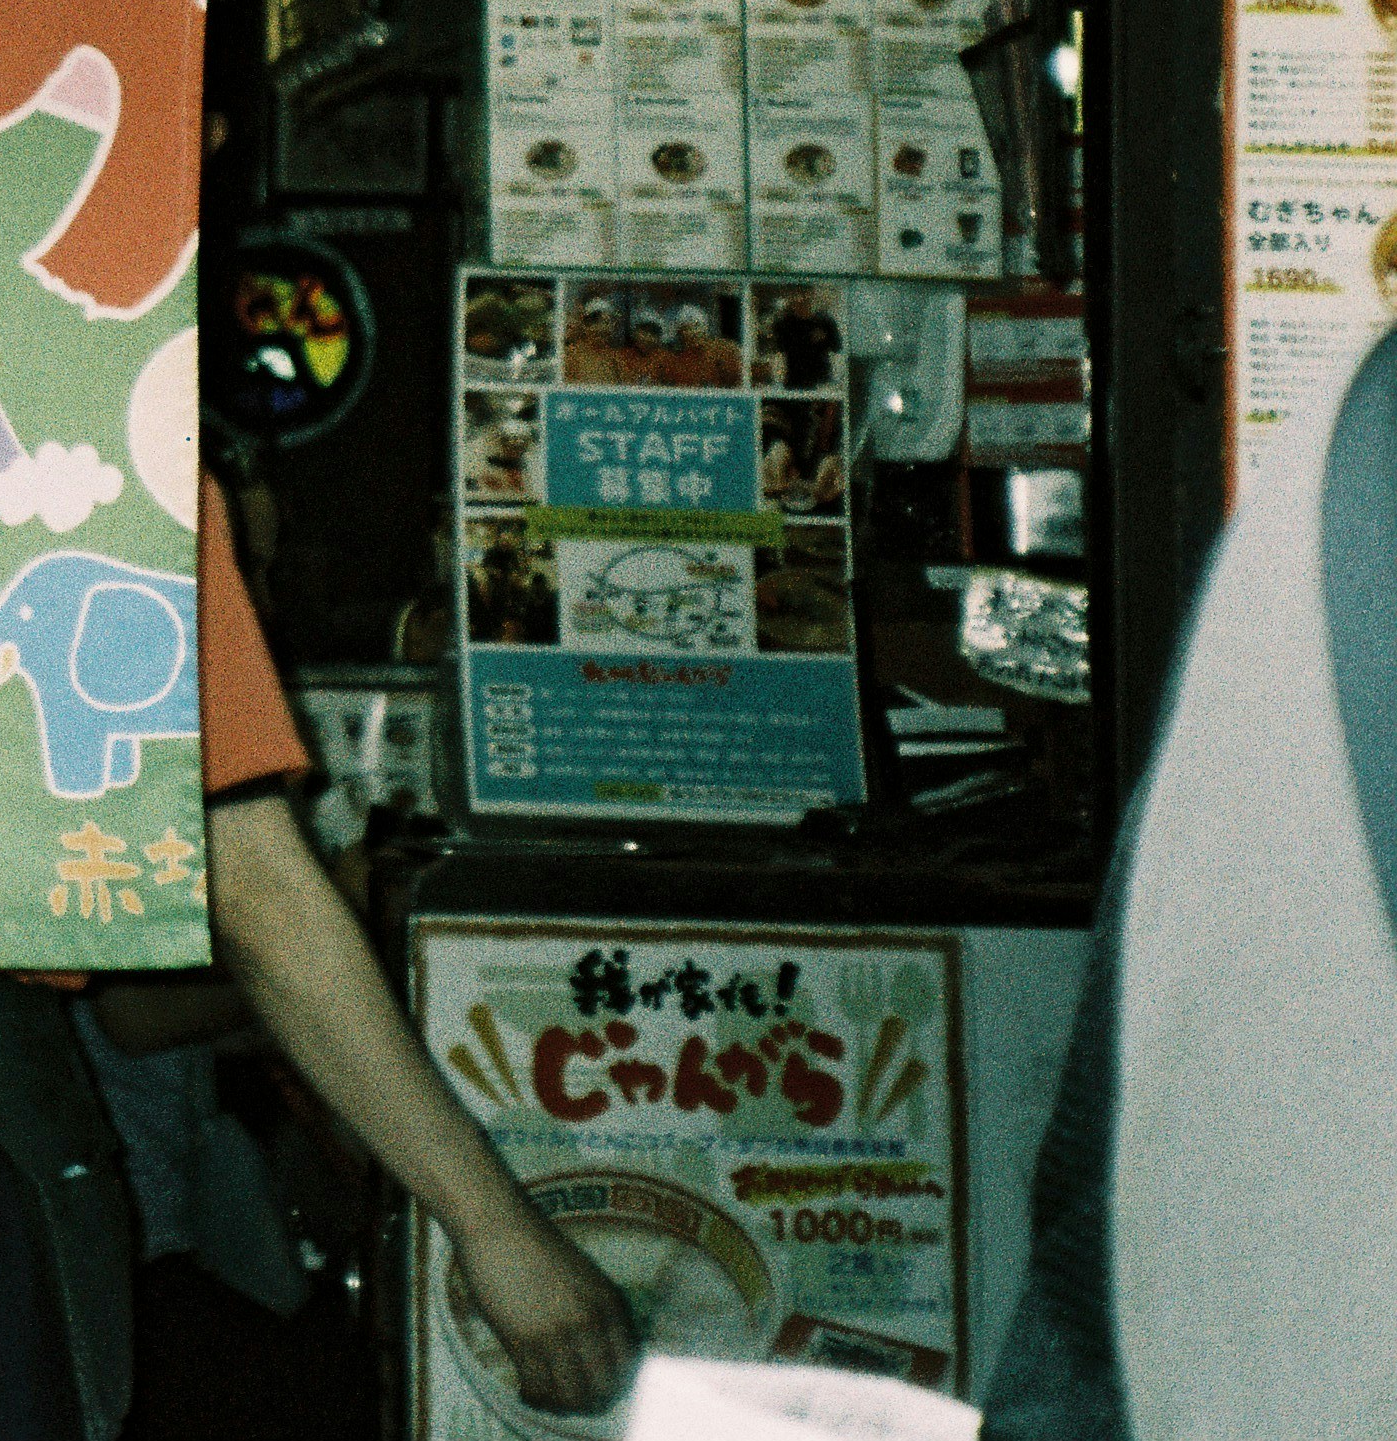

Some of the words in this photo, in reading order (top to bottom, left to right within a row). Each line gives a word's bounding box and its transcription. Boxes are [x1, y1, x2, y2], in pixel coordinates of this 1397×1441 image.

[576, 429, 731, 464] STAFF
[533, 1019, 845, 1127] じゃんがら
